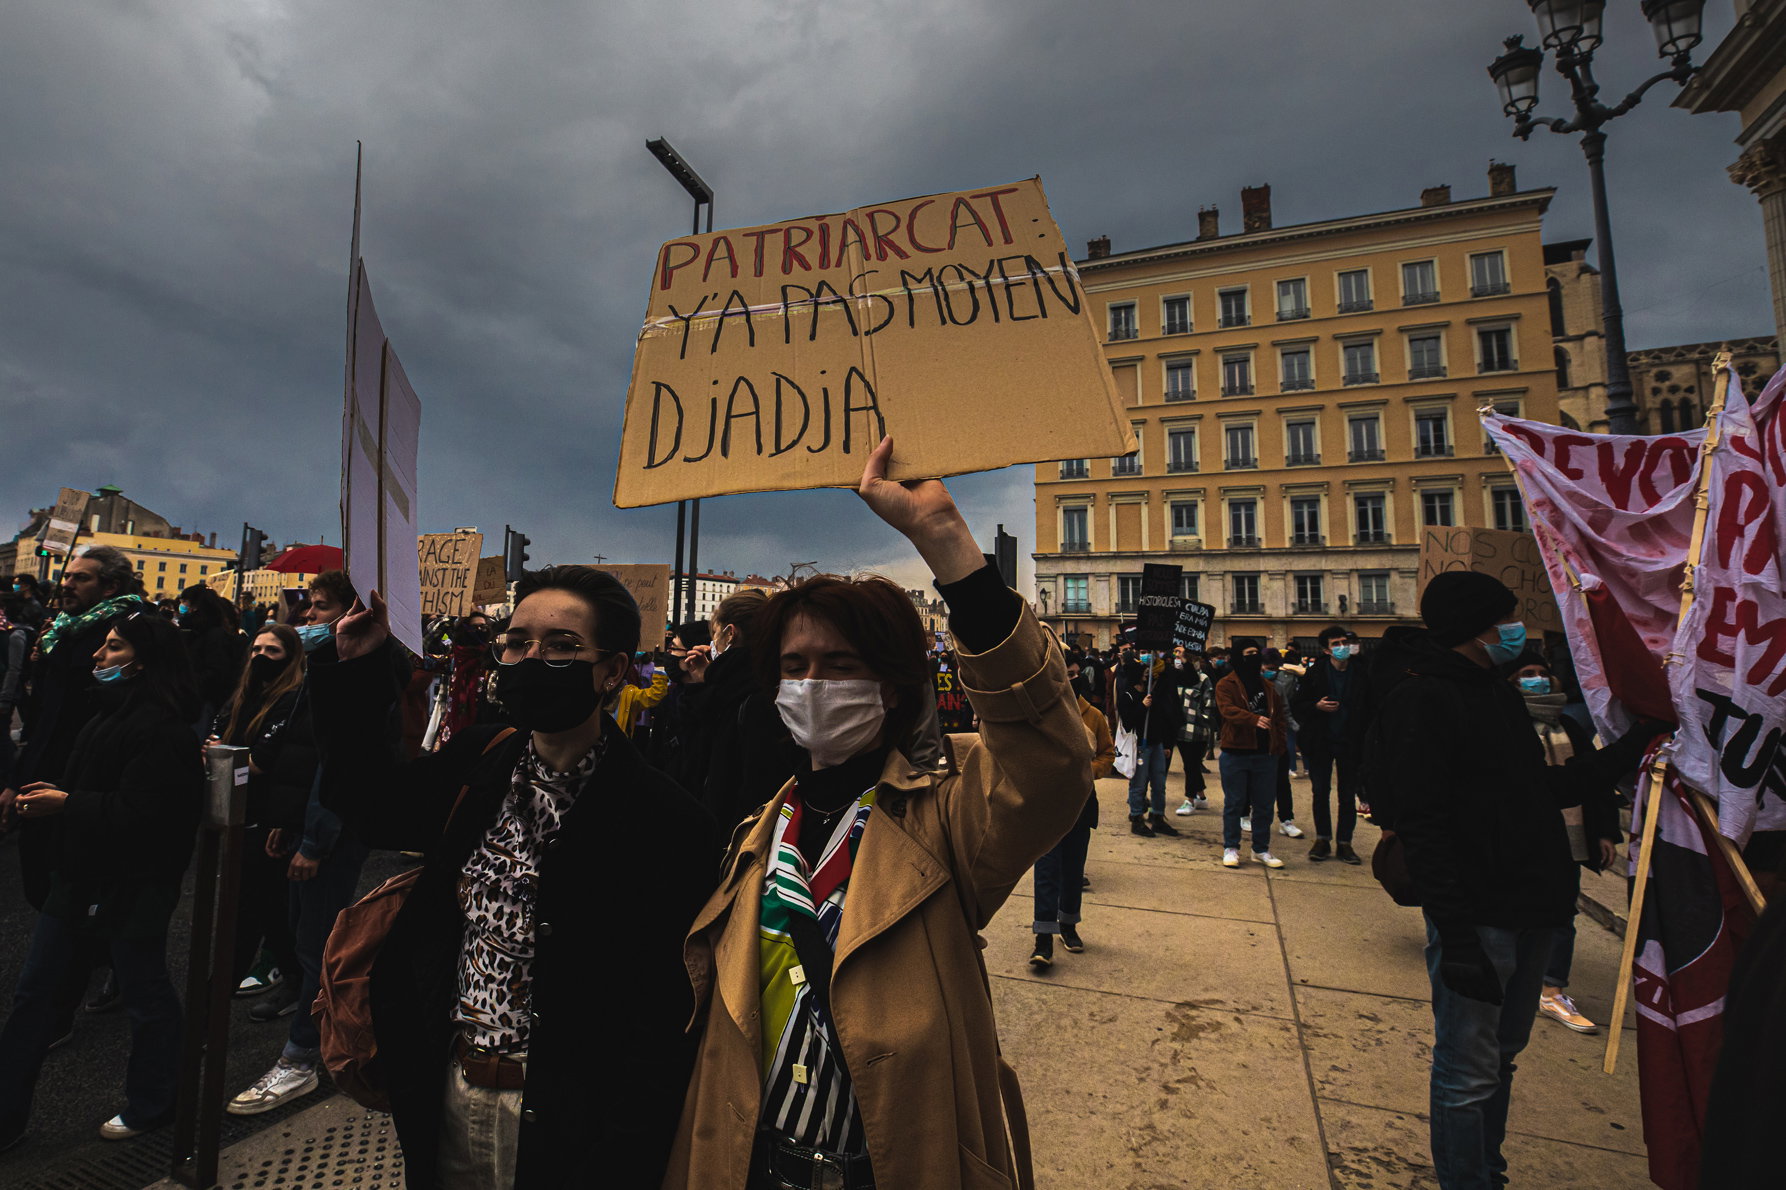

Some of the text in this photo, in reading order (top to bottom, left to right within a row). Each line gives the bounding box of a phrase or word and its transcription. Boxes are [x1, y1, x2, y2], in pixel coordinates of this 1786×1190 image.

[667, 251, 1081, 360] Y'A PAS MOYEN
[1426, 530, 1497, 558] NOS
[419, 567, 470, 588] INST THE
[420, 588, 464, 617] HISM
